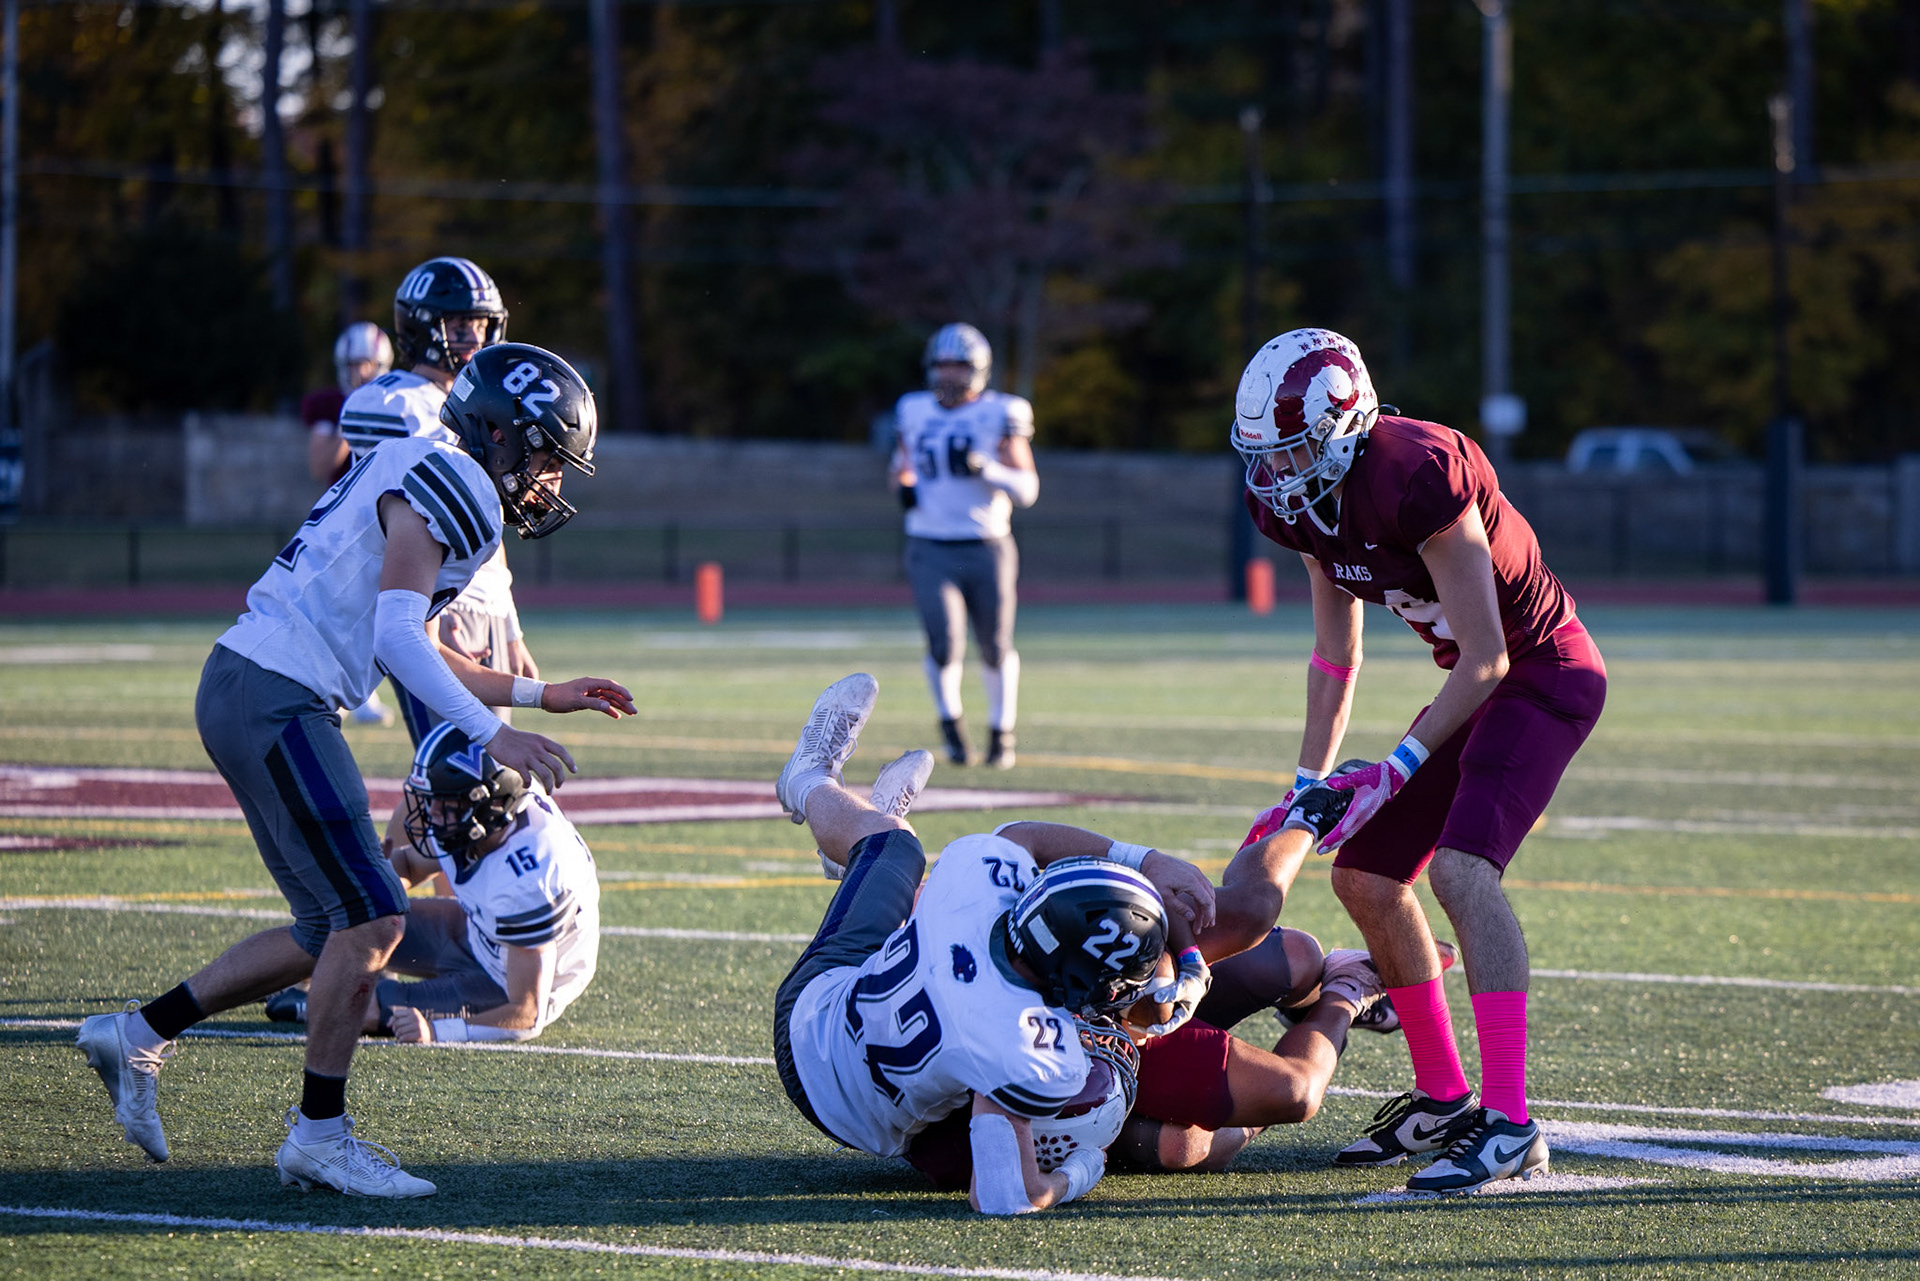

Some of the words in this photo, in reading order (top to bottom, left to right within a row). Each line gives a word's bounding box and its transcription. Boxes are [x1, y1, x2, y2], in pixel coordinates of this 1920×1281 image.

[405, 271, 435, 300] 10
[502, 362, 563, 419] 82
[1333, 561, 1373, 582] RAMS
[505, 846, 540, 878] 15
[1081, 918, 1141, 972] 22
[844, 917, 944, 1109] 22
[1027, 1015, 1067, 1055] 22
